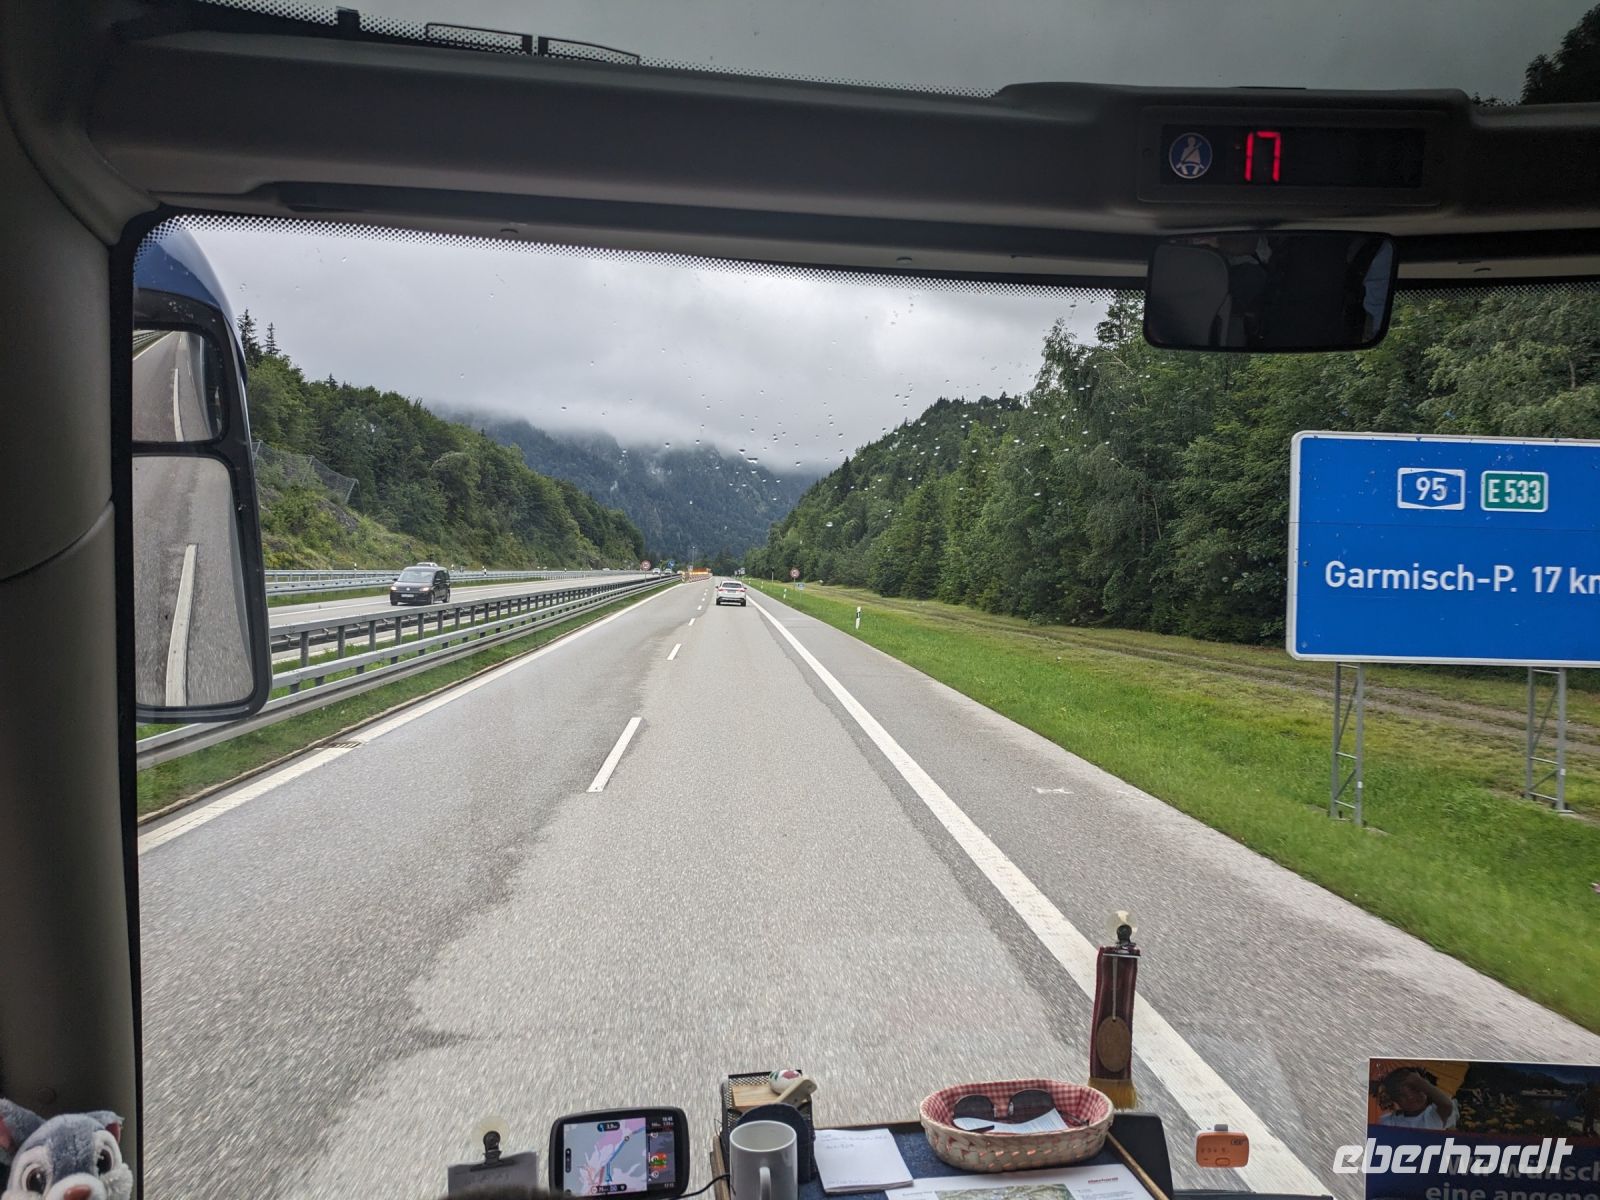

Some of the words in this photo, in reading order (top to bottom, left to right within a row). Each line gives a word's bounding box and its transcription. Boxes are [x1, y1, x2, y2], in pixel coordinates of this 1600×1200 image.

[1244, 130, 1281, 182] 17
[1415, 476, 1448, 501] 95
[1487, 478, 1500, 503] E
[1504, 479, 1541, 504] 533
[1325, 559, 1518, 593] Garmisch-P.
[1531, 565, 1563, 593] 17
